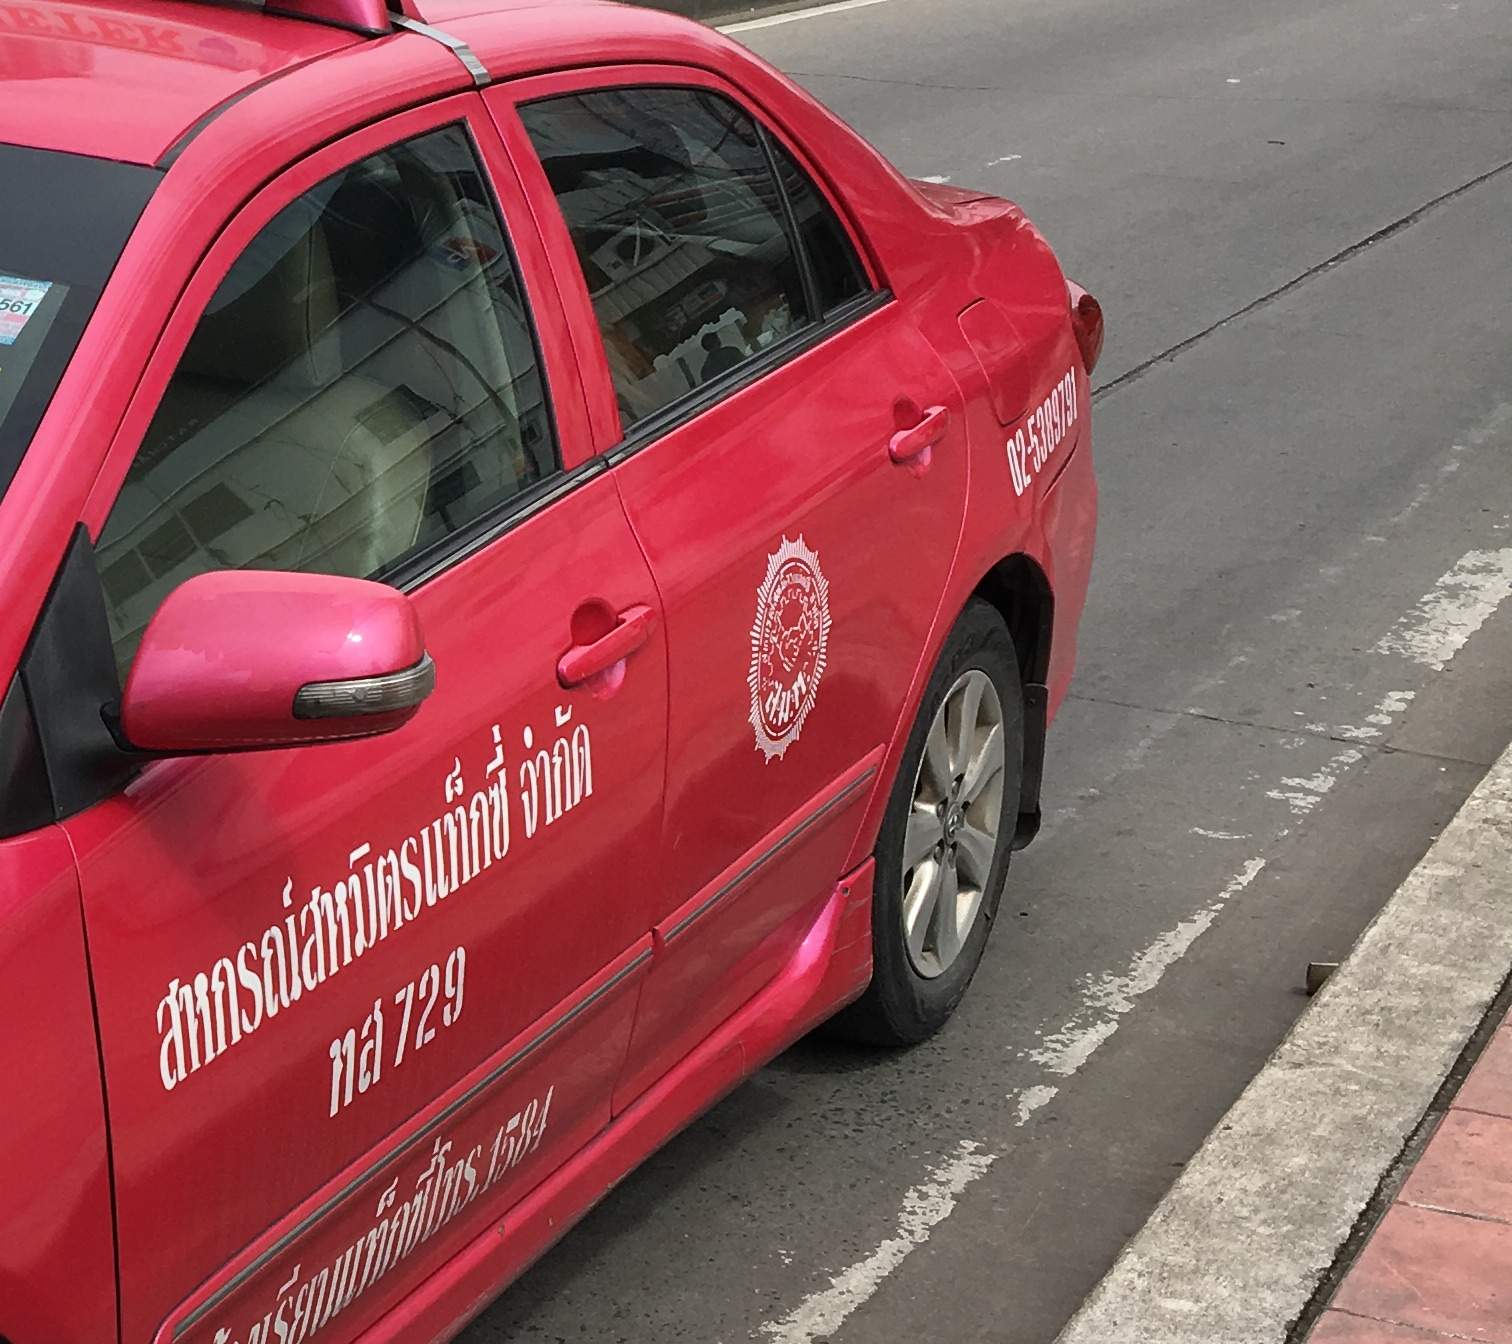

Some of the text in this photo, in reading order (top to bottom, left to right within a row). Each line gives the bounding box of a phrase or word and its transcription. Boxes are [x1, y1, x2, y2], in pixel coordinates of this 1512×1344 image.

[155, 704, 593, 1092] สหกรณ์สหมิตรแท็กซี่ จำกัด
[393, 946, 466, 1068] 729
